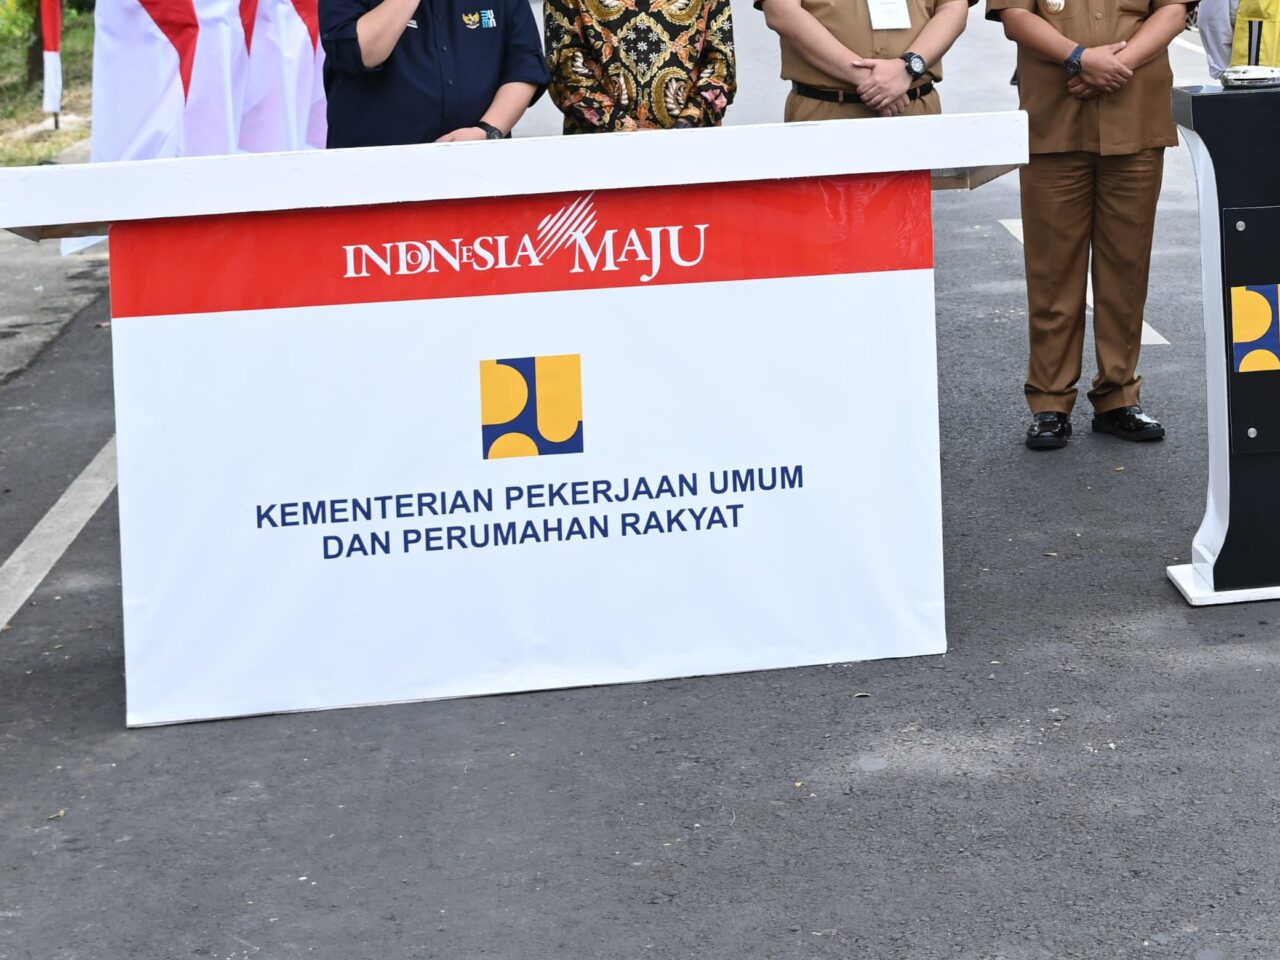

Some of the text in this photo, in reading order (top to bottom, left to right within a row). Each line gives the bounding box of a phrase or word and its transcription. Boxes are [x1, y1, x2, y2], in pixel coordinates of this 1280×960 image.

[343, 224, 709, 282] INDONESIA MAJU
[256, 464, 803, 529] KEMENTERIAN PEKERJAAN UMUM
[322, 503, 744, 560] DAN PERUMAHAN RAKYAT
